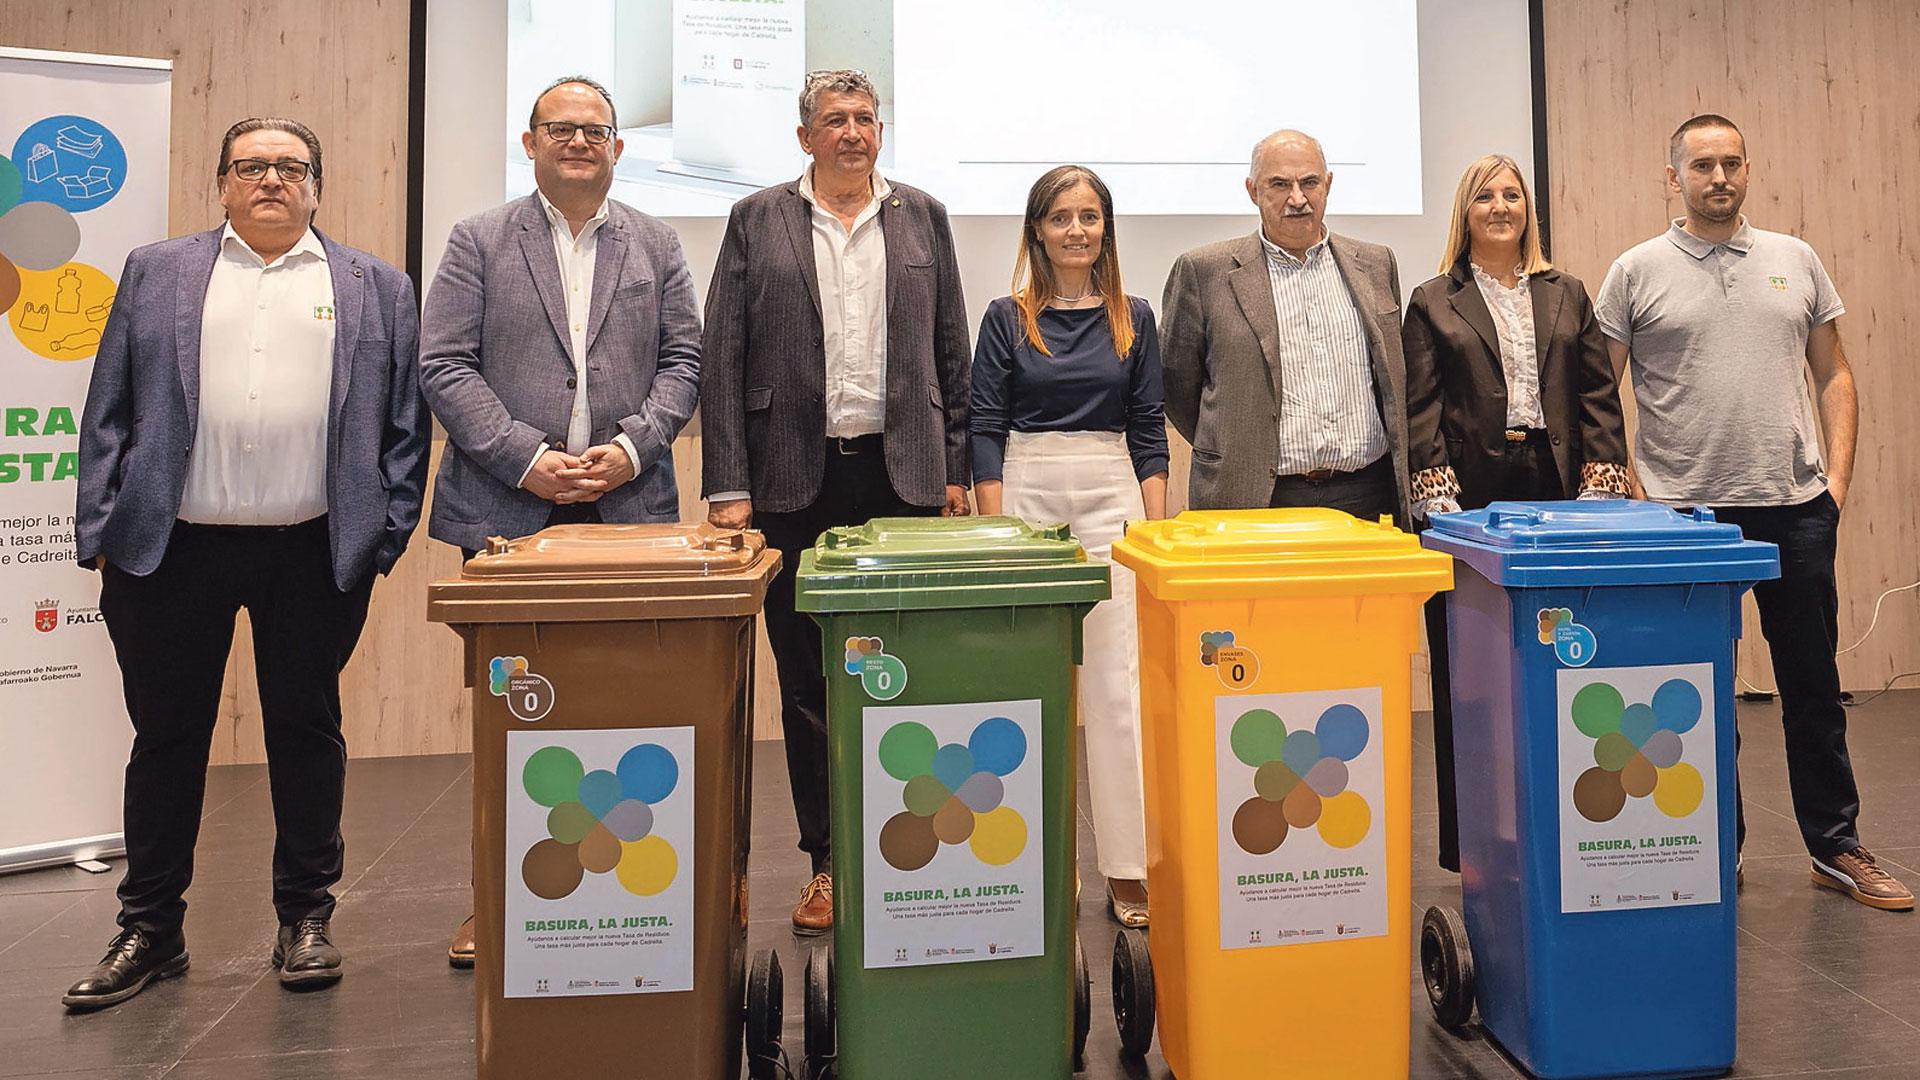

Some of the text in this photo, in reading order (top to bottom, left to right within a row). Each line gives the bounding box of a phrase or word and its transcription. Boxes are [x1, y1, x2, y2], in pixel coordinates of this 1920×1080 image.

[5, 406, 78, 437] RA
[0, 516, 42, 531] mejor
[47, 514, 60, 526] la
[10, 535, 44, 546] tasa
[1570, 641, 1582, 659] 0
[40, 672, 82, 681] Gobernua
[46, 664, 78, 672] Navarra
[1232, 664, 1245, 682] 0
[878, 672, 891, 690] 0
[524, 692, 538, 712] 0
[1578, 835, 1702, 852] BASURA, LA JUSTA.
[1238, 866, 1369, 886] BASURA, LA JUSTA.
[883, 884, 1024, 902] BASURA, LA JUSTA.
[525, 916, 673, 932] BASURA, LA JUSTA.
